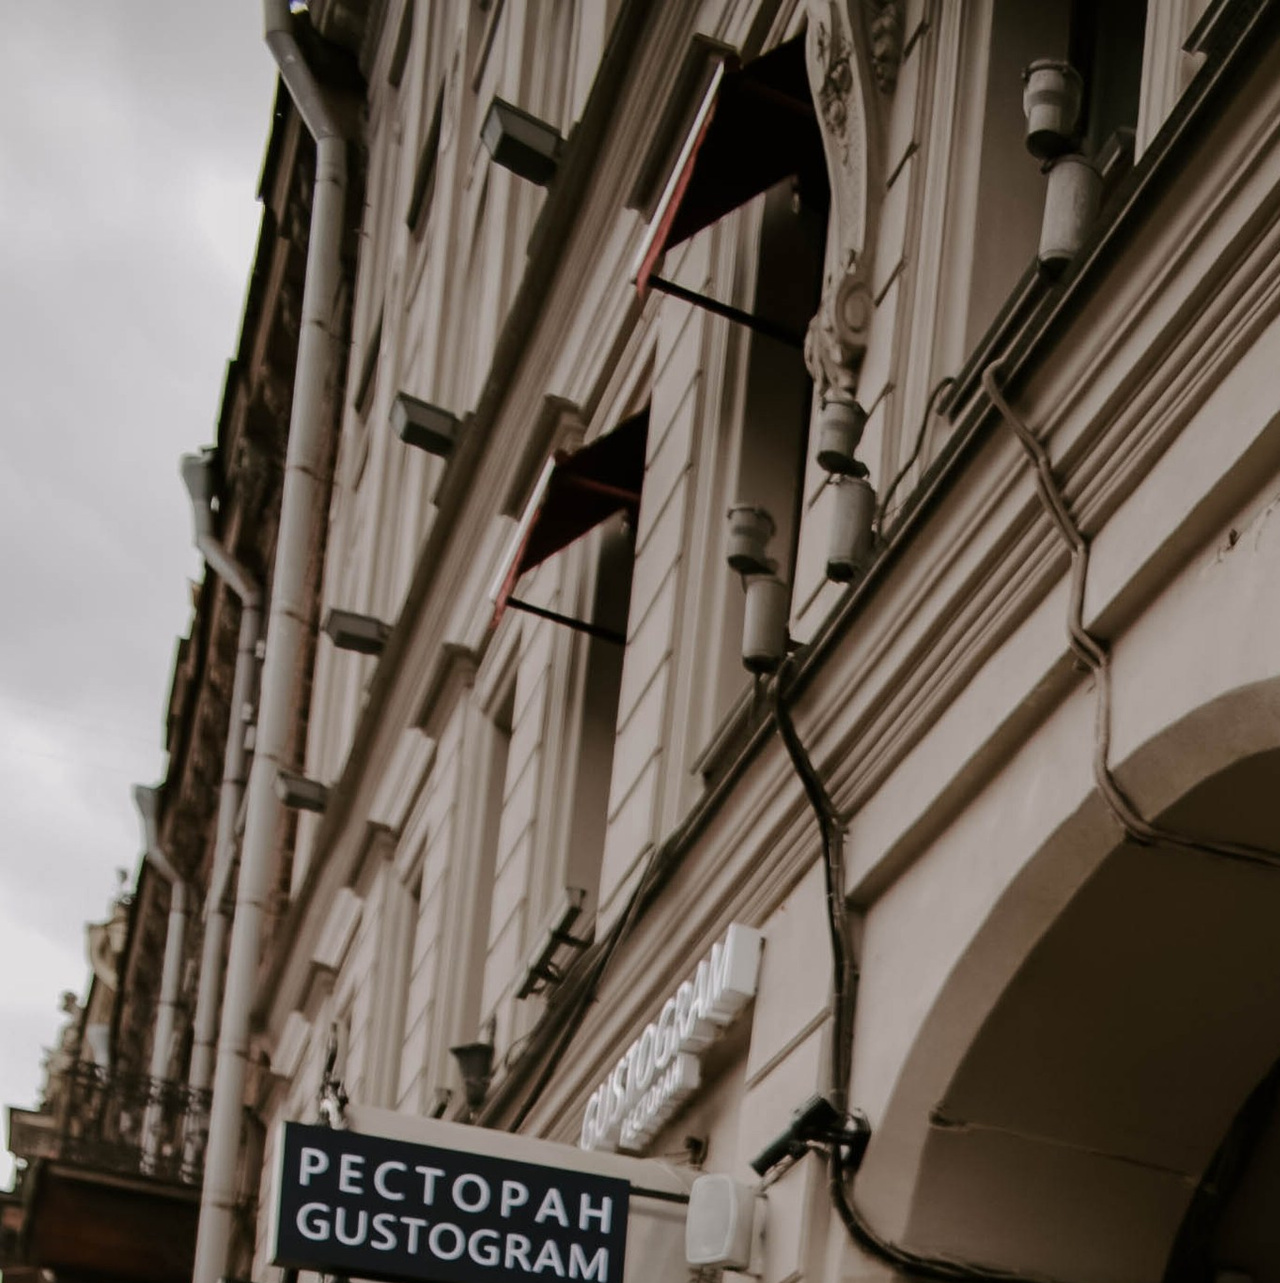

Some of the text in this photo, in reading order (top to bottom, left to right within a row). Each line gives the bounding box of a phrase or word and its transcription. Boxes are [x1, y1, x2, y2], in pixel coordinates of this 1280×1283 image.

[580, 922, 740, 1151] GUSTOGRAM
[298, 1146, 614, 1234] РЕСТОРАН
[295, 1202, 611, 1283] GUSTOGRAM
